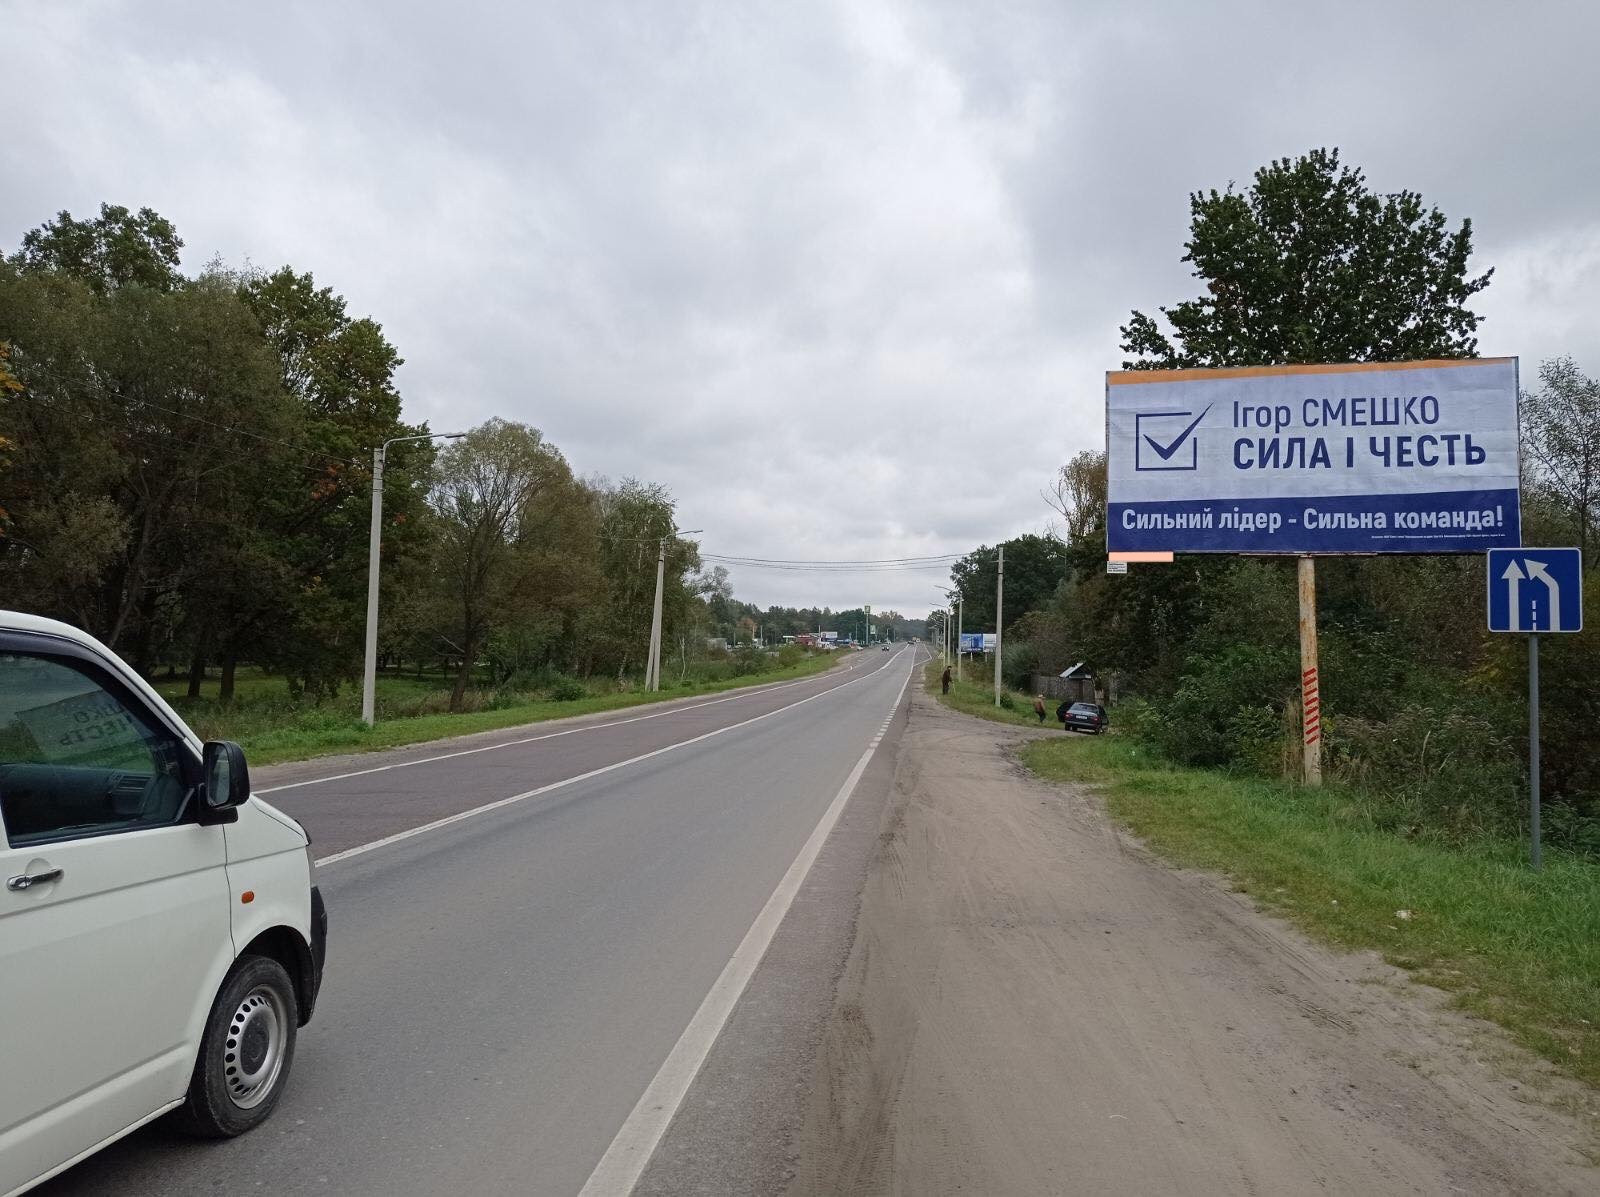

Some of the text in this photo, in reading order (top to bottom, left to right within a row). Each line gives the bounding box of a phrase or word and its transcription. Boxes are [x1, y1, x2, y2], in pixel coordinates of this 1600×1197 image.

[1233, 395, 1440, 434] Ігор СМЕШКО
[1233, 433, 1487, 470] СИЛА І ЧЕСТЬ
[1122, 507, 1213, 530] Сильний
[1218, 506, 1282, 534] лідер
[1303, 507, 1387, 530] Сильна
[1394, 505, 1503, 531] команда!
